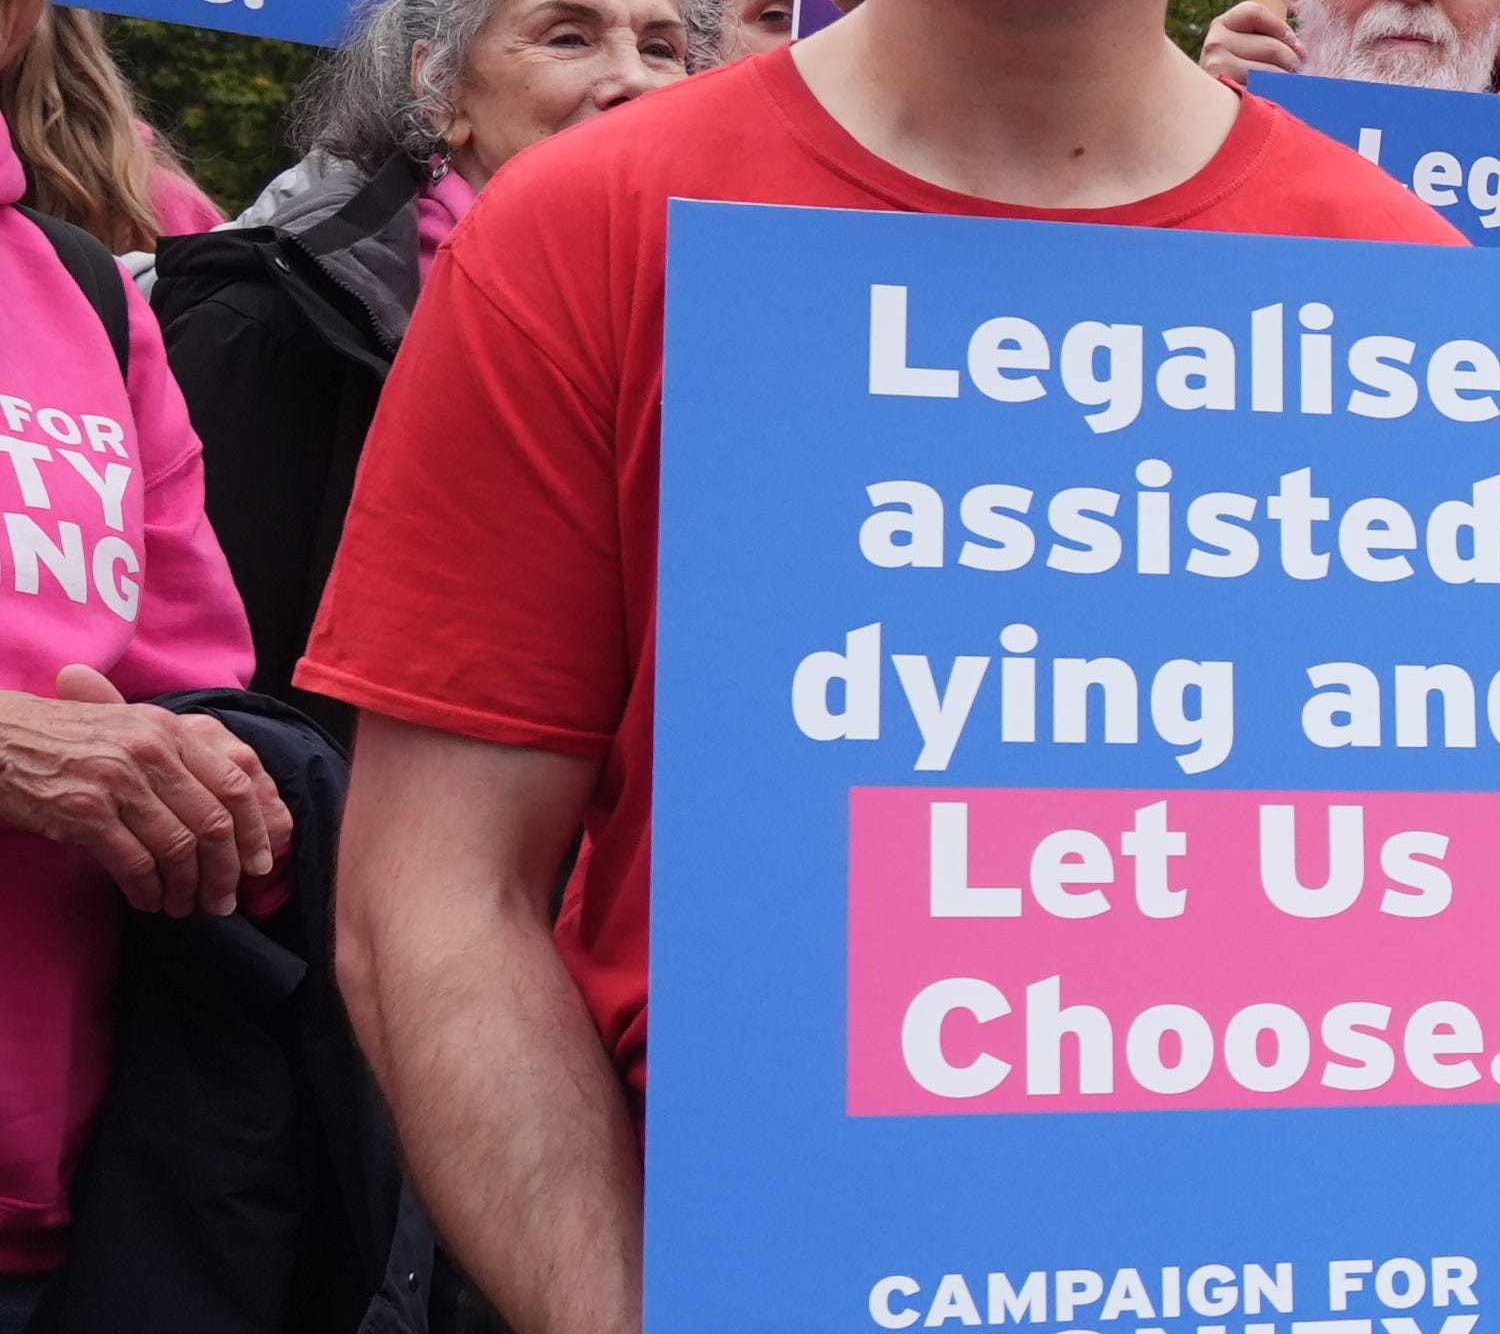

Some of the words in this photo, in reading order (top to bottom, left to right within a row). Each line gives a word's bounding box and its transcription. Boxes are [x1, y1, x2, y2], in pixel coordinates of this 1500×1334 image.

[0, 394, 128, 459] FOR
[794, 624, 1233, 773] dying
[931, 801, 1186, 918] Let
[1260, 805, 1452, 917] Us
[871, 1264, 1293, 1328] CAMPAIGN
[1330, 1257, 1477, 1310] FOR
